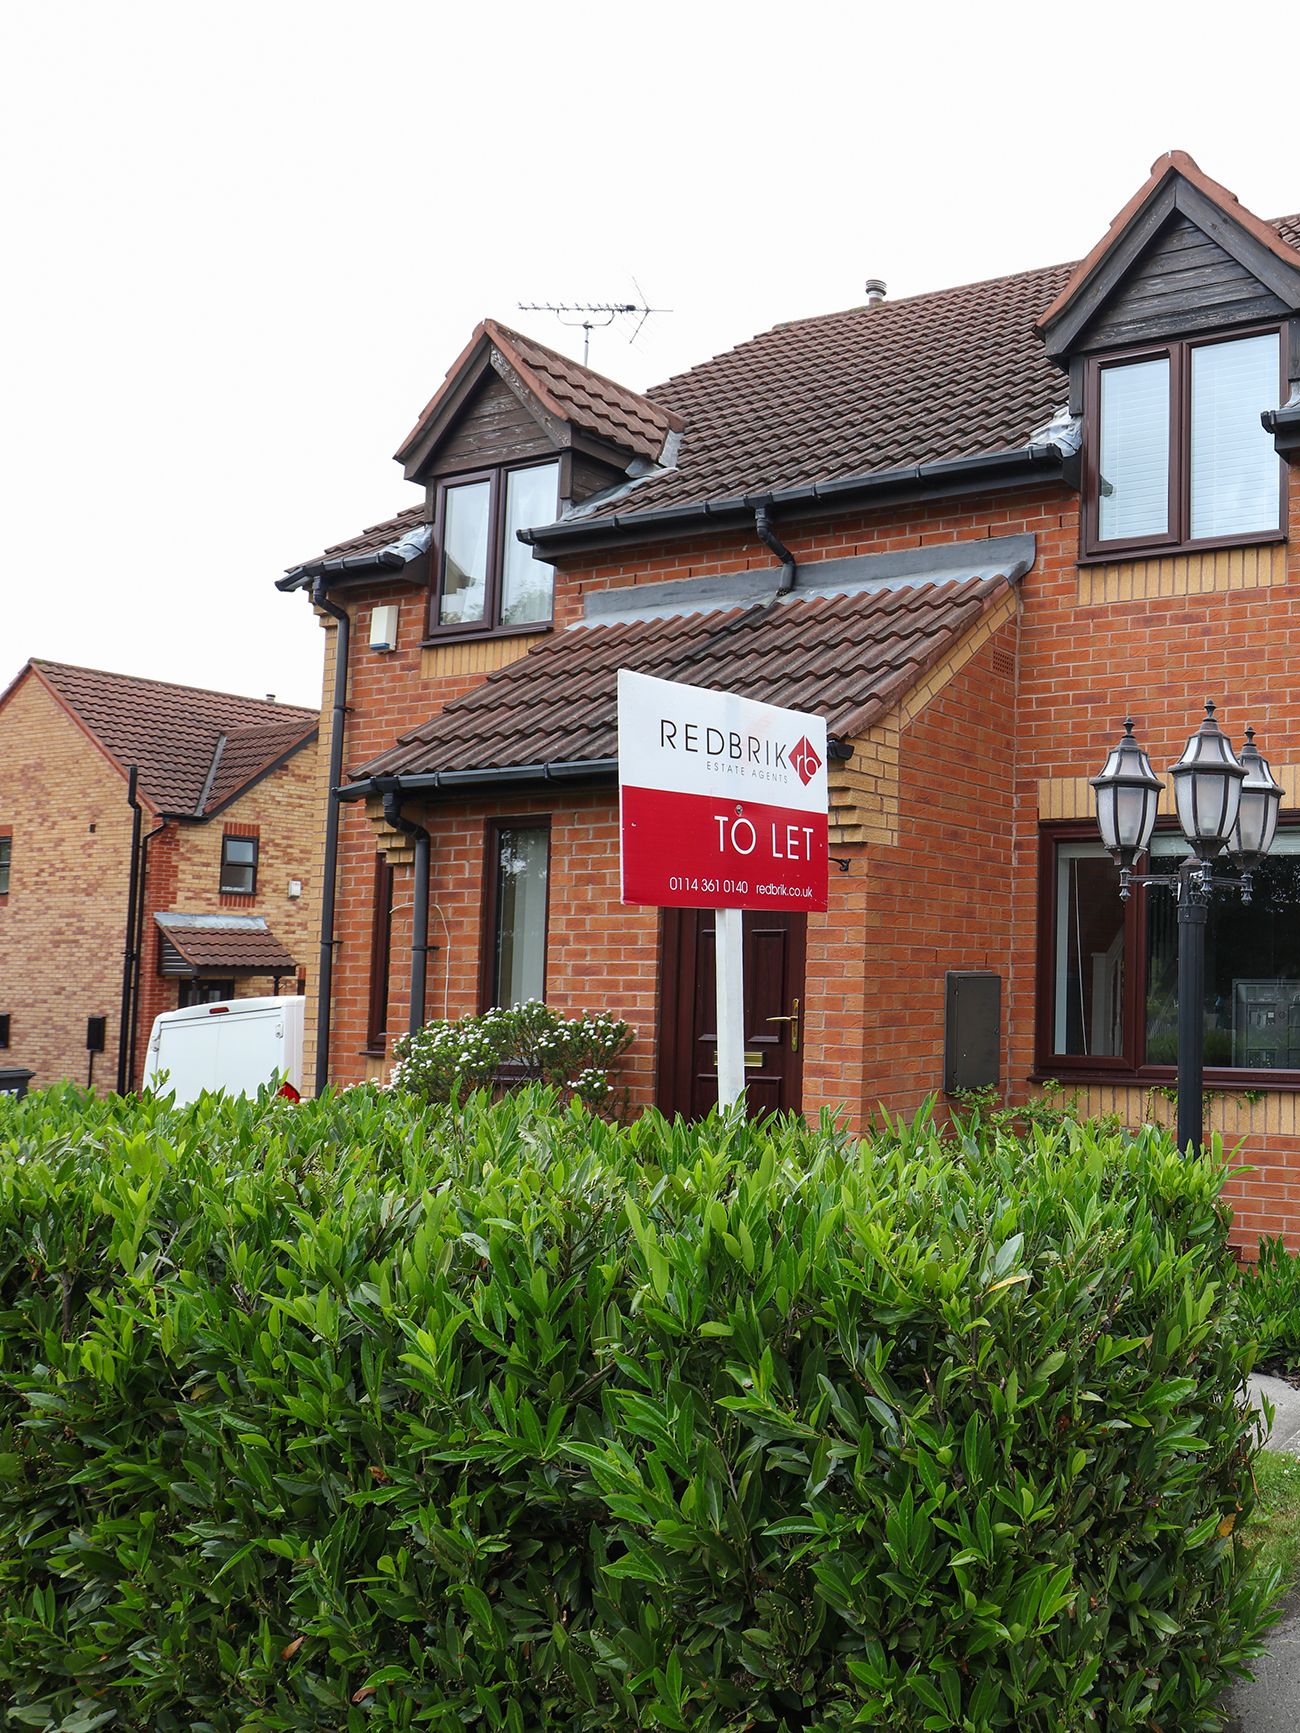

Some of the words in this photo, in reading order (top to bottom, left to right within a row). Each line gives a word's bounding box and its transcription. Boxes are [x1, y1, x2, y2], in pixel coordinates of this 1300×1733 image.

[660, 719, 787, 770] REDBRIK
[796, 736, 819, 778] rb
[706, 761, 745, 776] ESTATE
[751, 770, 788, 784] AGENTS
[714, 815, 756, 855] TO
[773, 823, 814, 861] LET
[669, 876, 698, 892] 0114
[701, 879, 720, 893] 361
[723, 881, 749, 895] 0140
[756, 883, 813, 898] redbrik.co.uk
